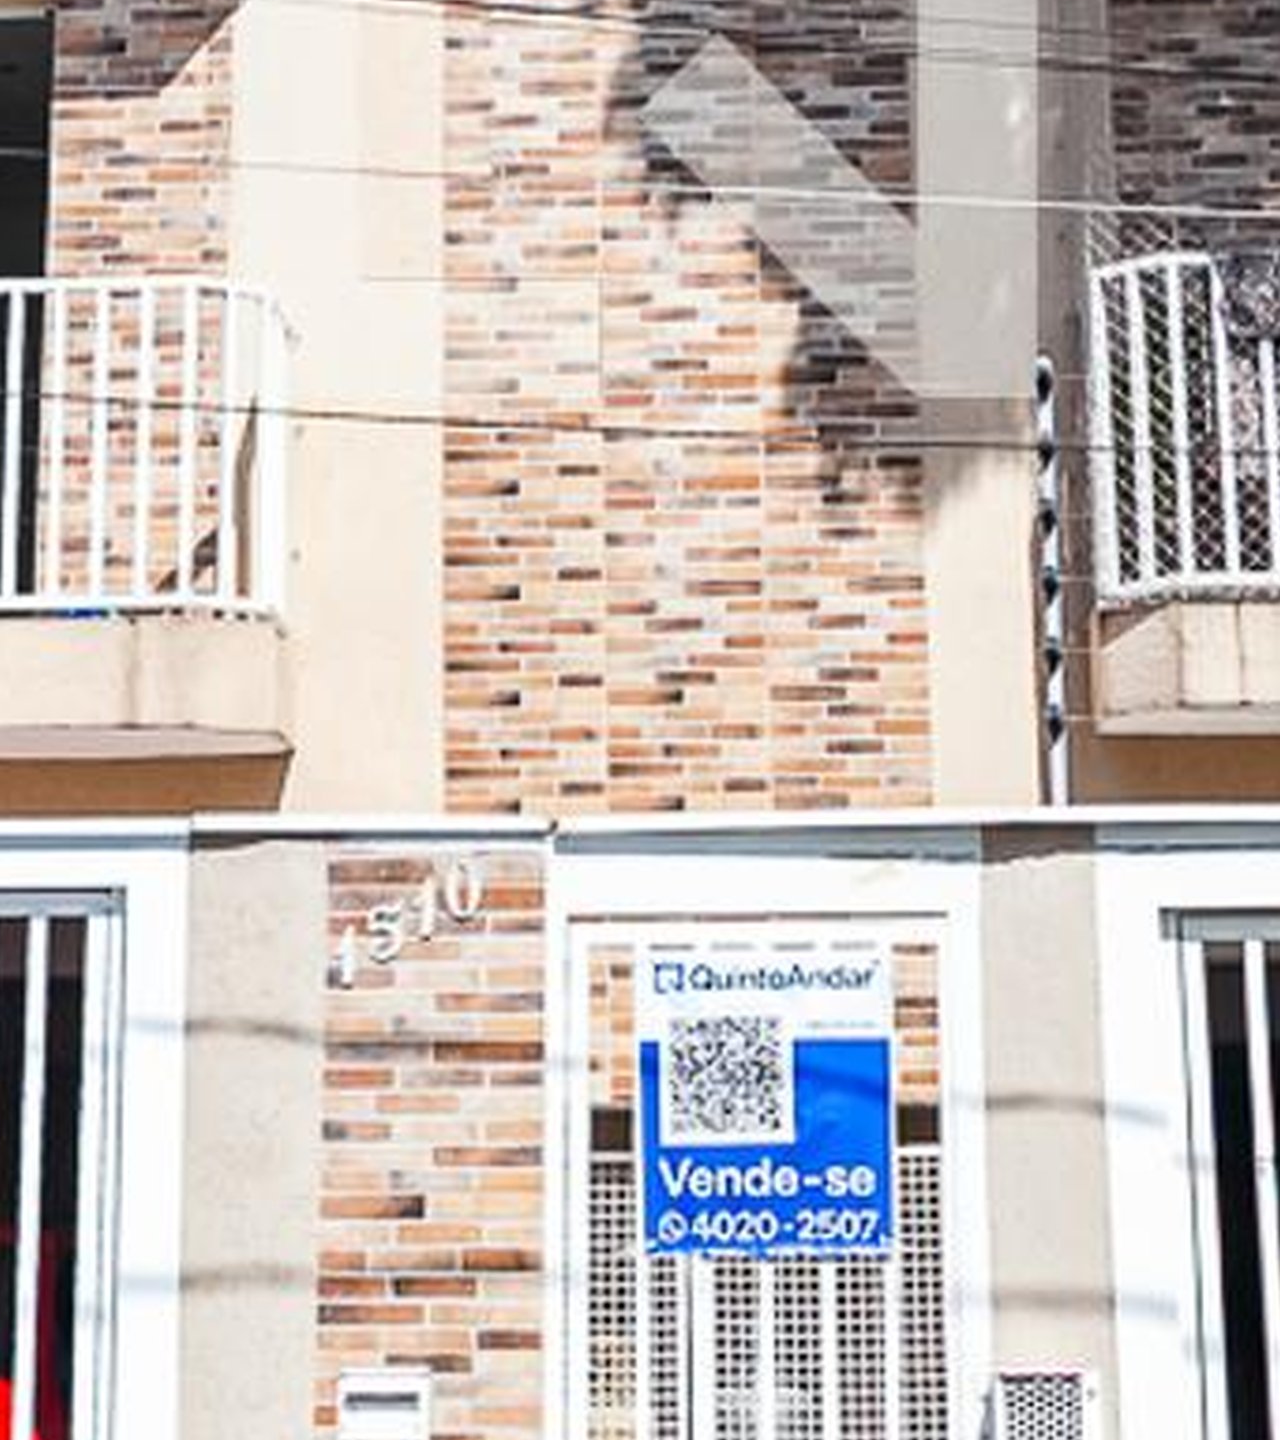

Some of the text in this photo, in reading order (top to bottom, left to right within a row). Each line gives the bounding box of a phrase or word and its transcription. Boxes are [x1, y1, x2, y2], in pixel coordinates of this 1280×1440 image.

[688, 962, 875, 991] QuintoAndar
[657, 1154, 877, 1200] Vende-se
[691, 1208, 879, 1242] 4020-2507
